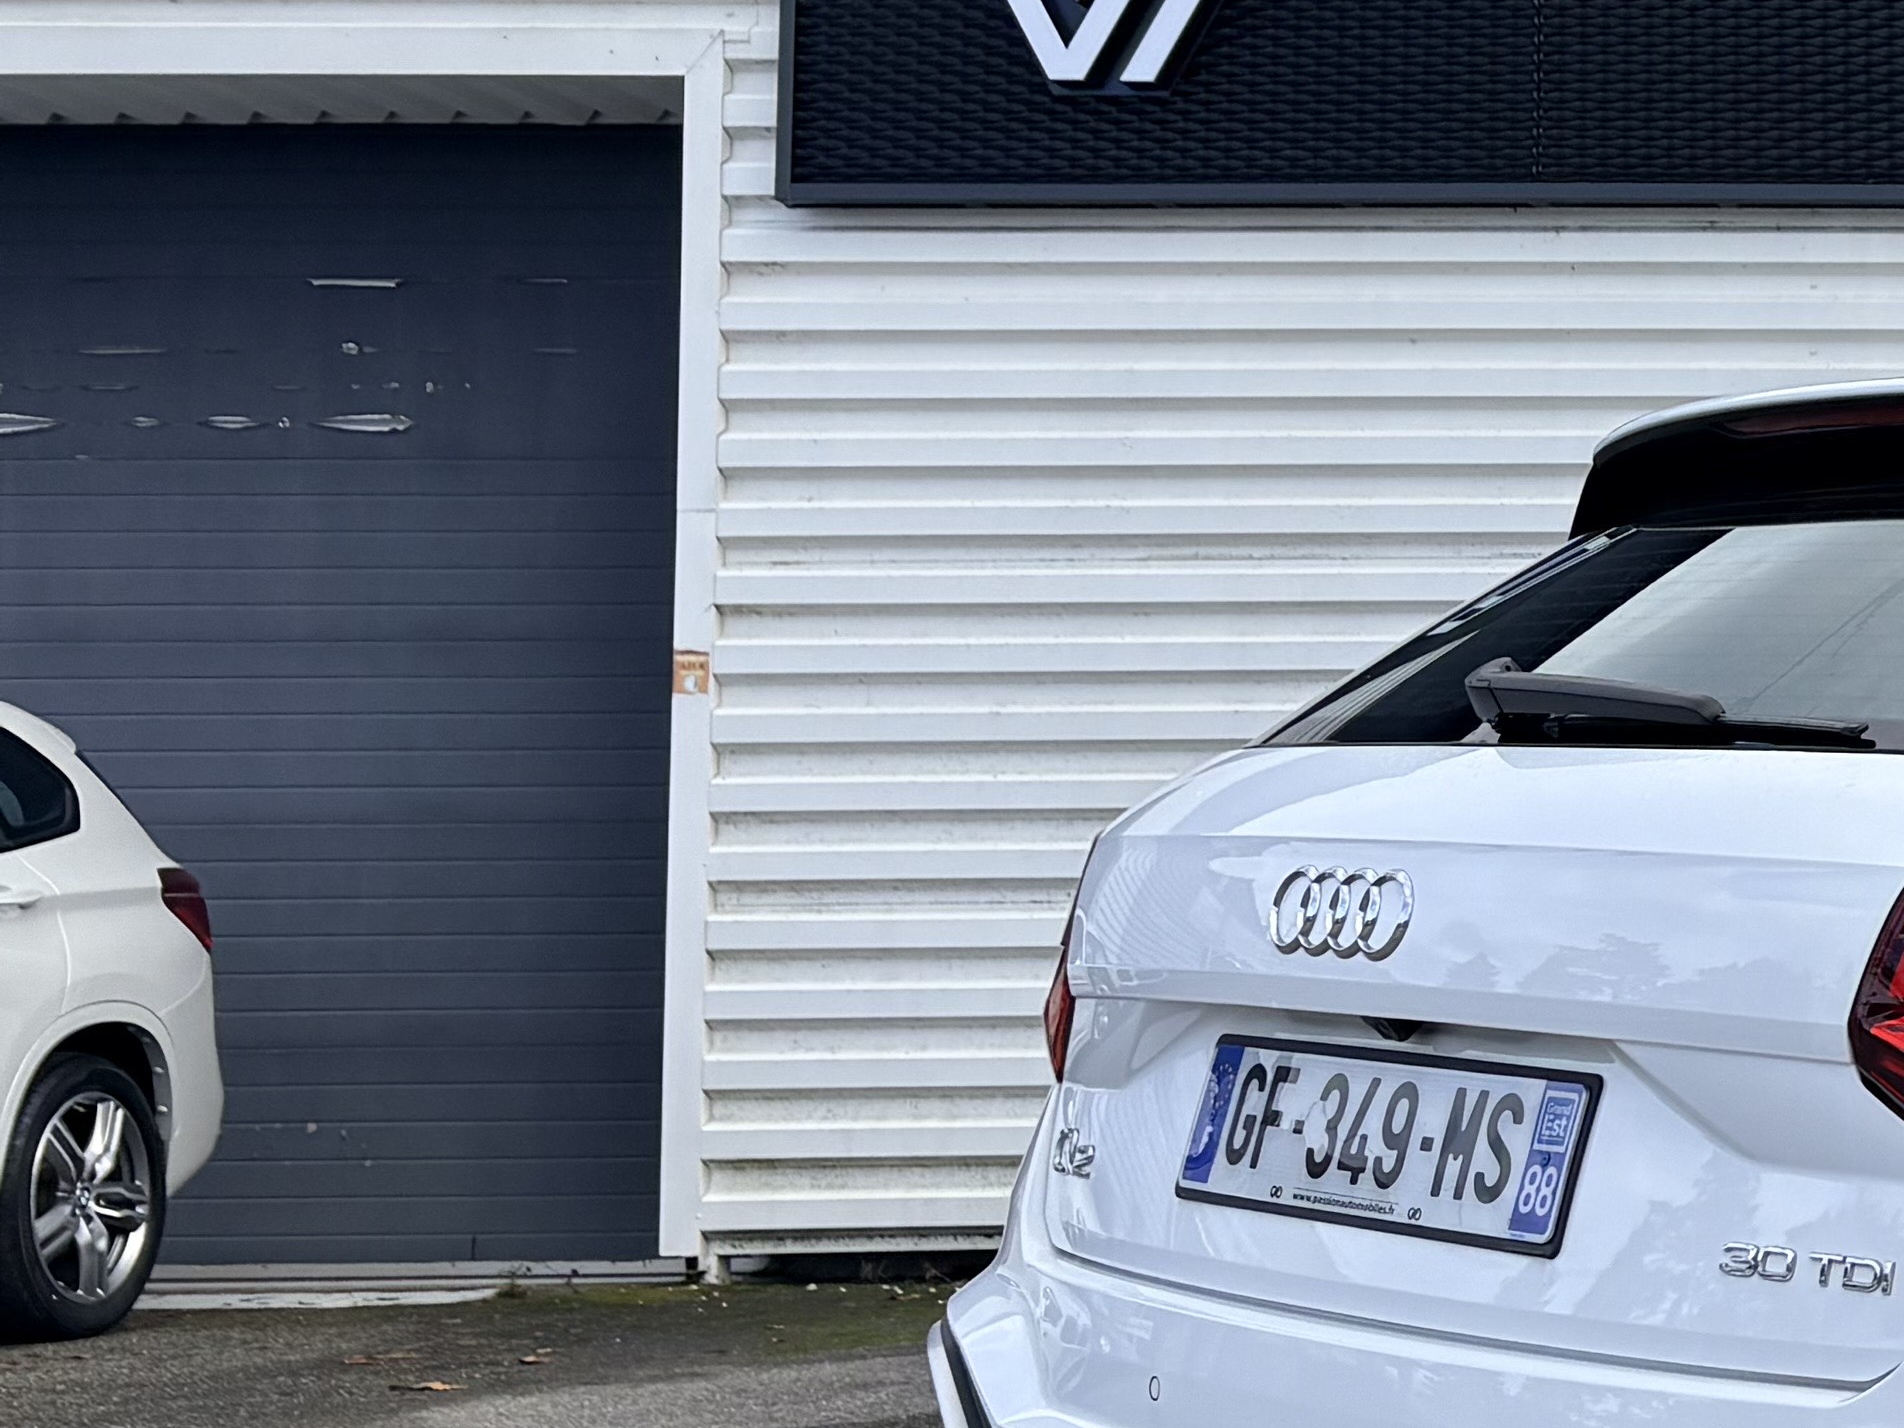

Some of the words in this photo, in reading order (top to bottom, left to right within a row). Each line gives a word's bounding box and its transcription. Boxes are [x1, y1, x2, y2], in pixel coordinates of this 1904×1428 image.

[1225, 1062, 1525, 1205] GF-349-MS
[1541, 1115, 1568, 1137] Est
[1547, 1102, 1573, 1115] Grand
[1518, 1164, 1558, 1217] 88
[1719, 1241, 1798, 1283] 30
[1808, 1251, 1897, 1297] TDI
